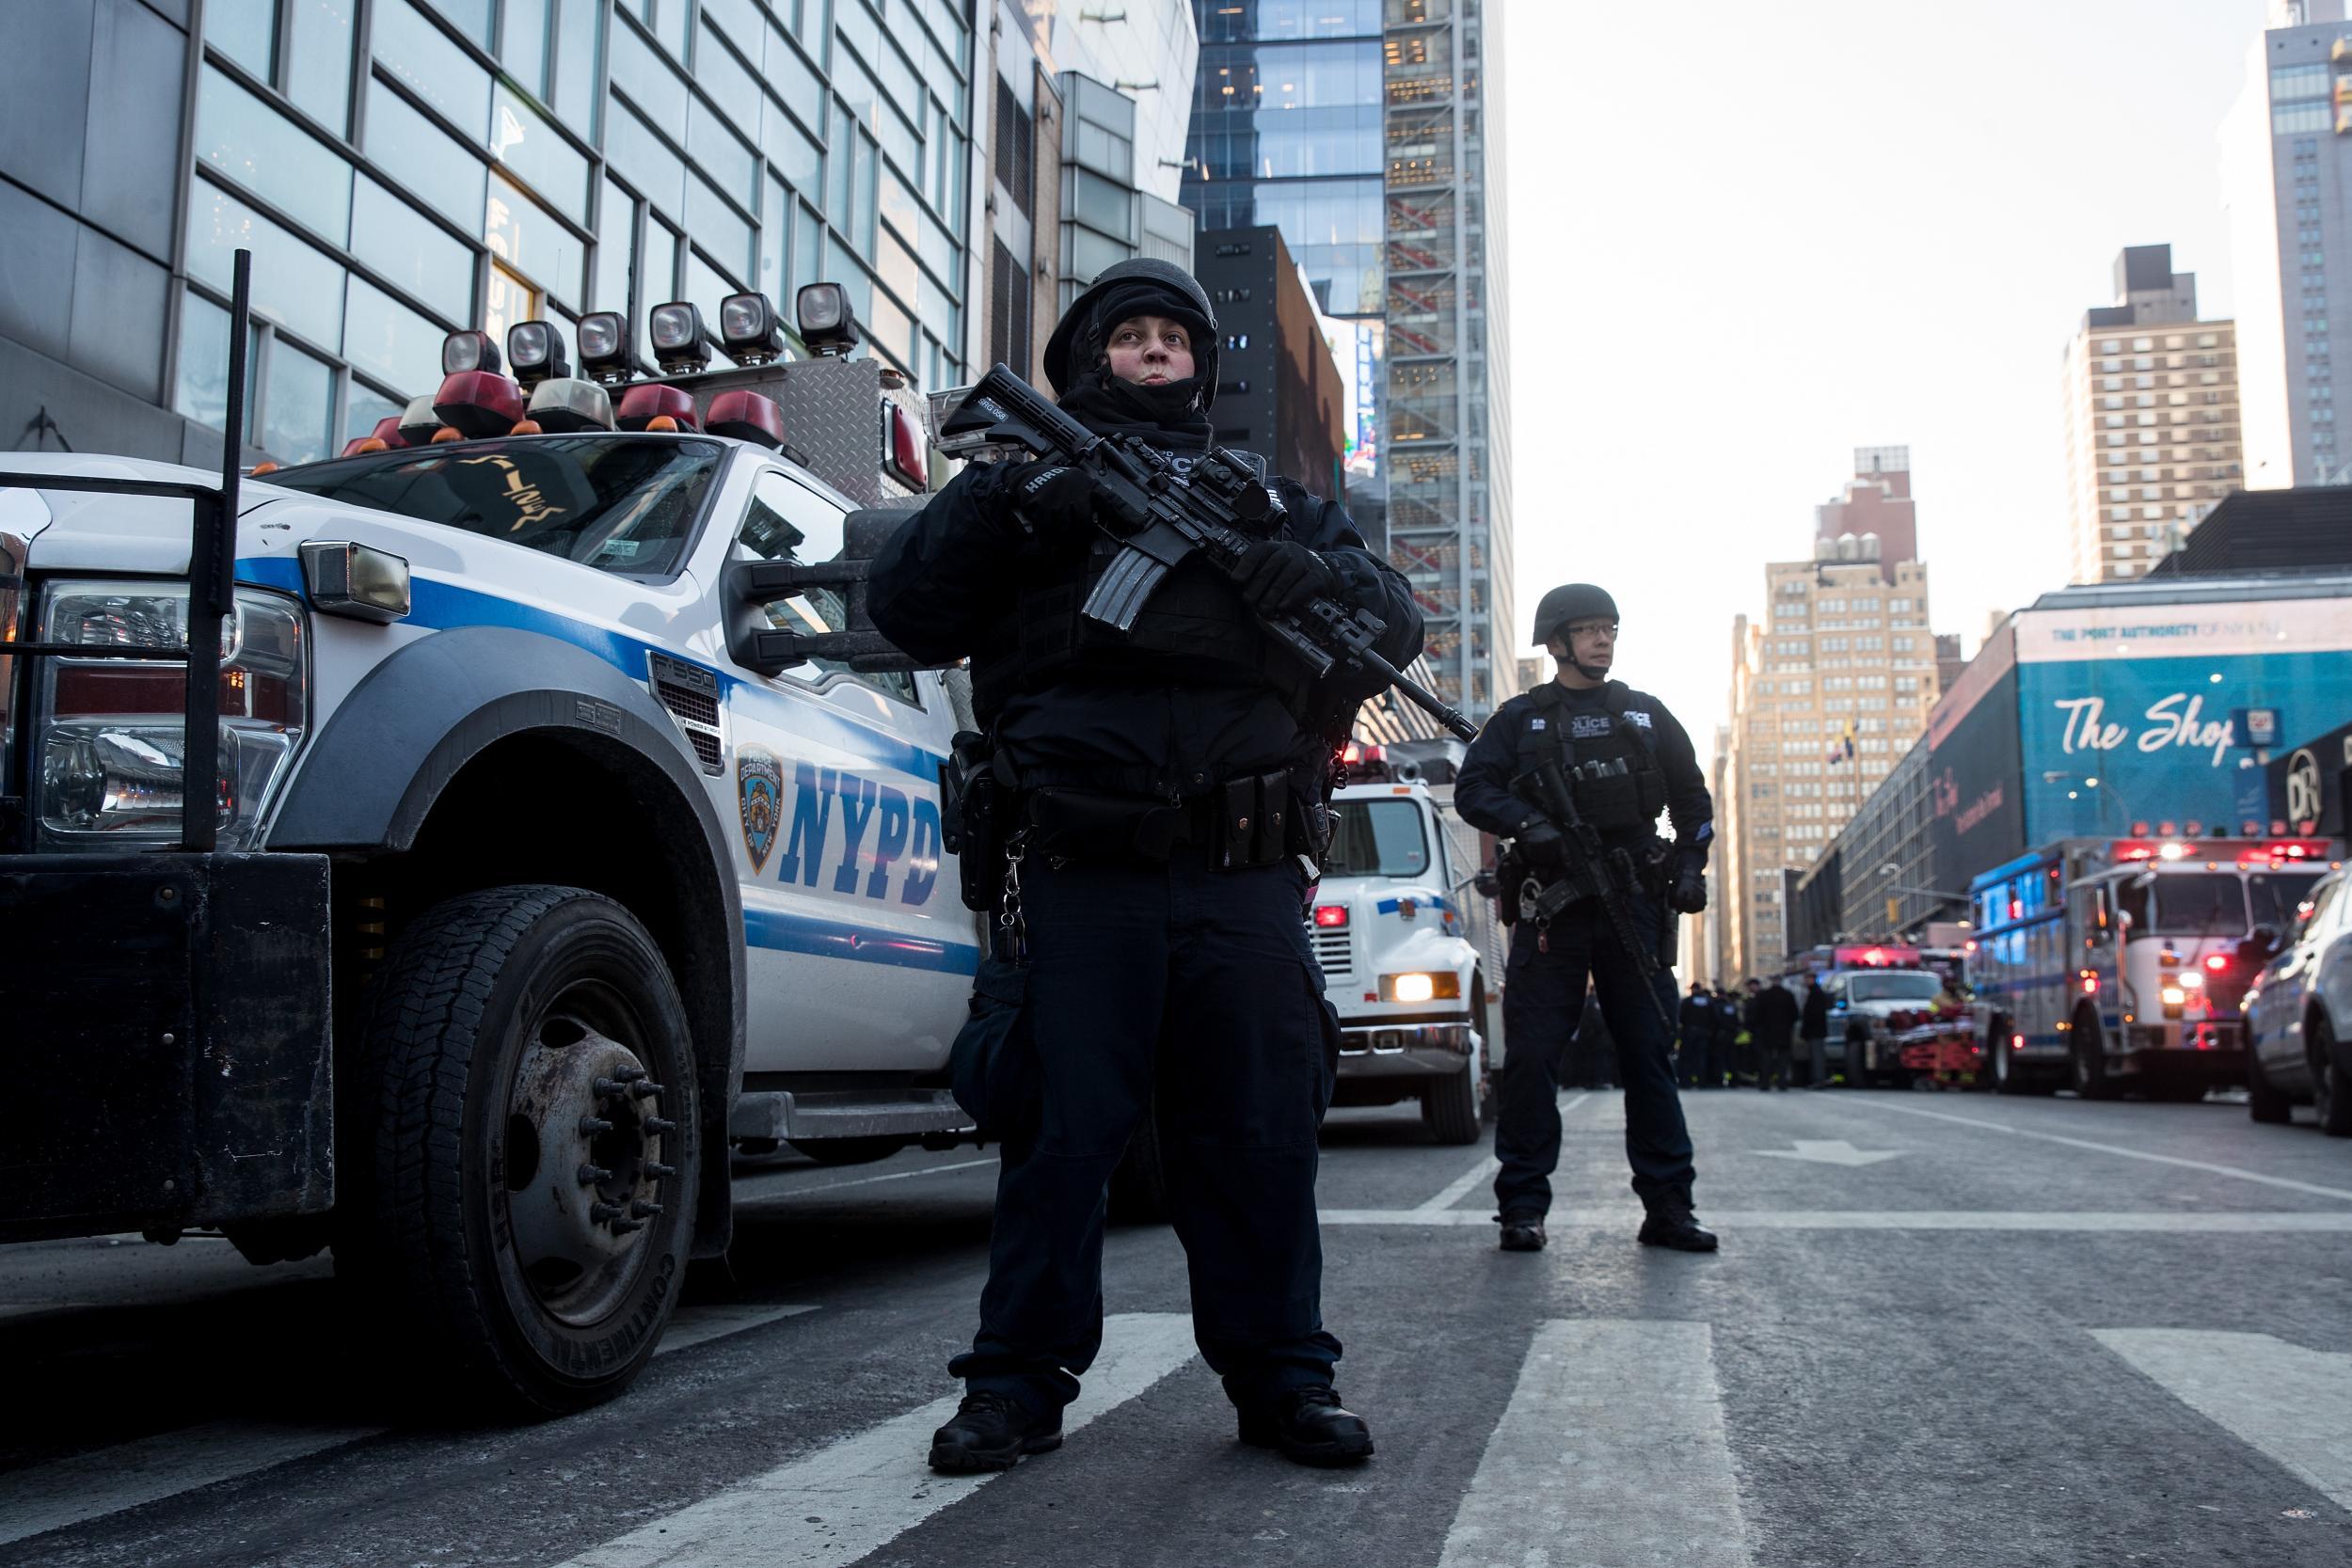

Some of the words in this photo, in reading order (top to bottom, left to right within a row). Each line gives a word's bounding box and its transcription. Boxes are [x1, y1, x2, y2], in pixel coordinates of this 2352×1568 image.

[978, 398, 993, 411] SRG
[993, 408, 1006, 420] 058
[2082, 627, 2116, 640] PORT
[2121, 624, 2198, 639] AUTHORITY
[2054, 696, 2129, 754] The
[748, 751, 773, 768] POLICE
[740, 764, 781, 789] DEPARTMENT
[741, 797, 750, 828] CITY
[771, 798, 781, 828] YORK
[778, 757, 940, 906] NYPD
[551, 1252, 675, 1371] CONTINENTAL
